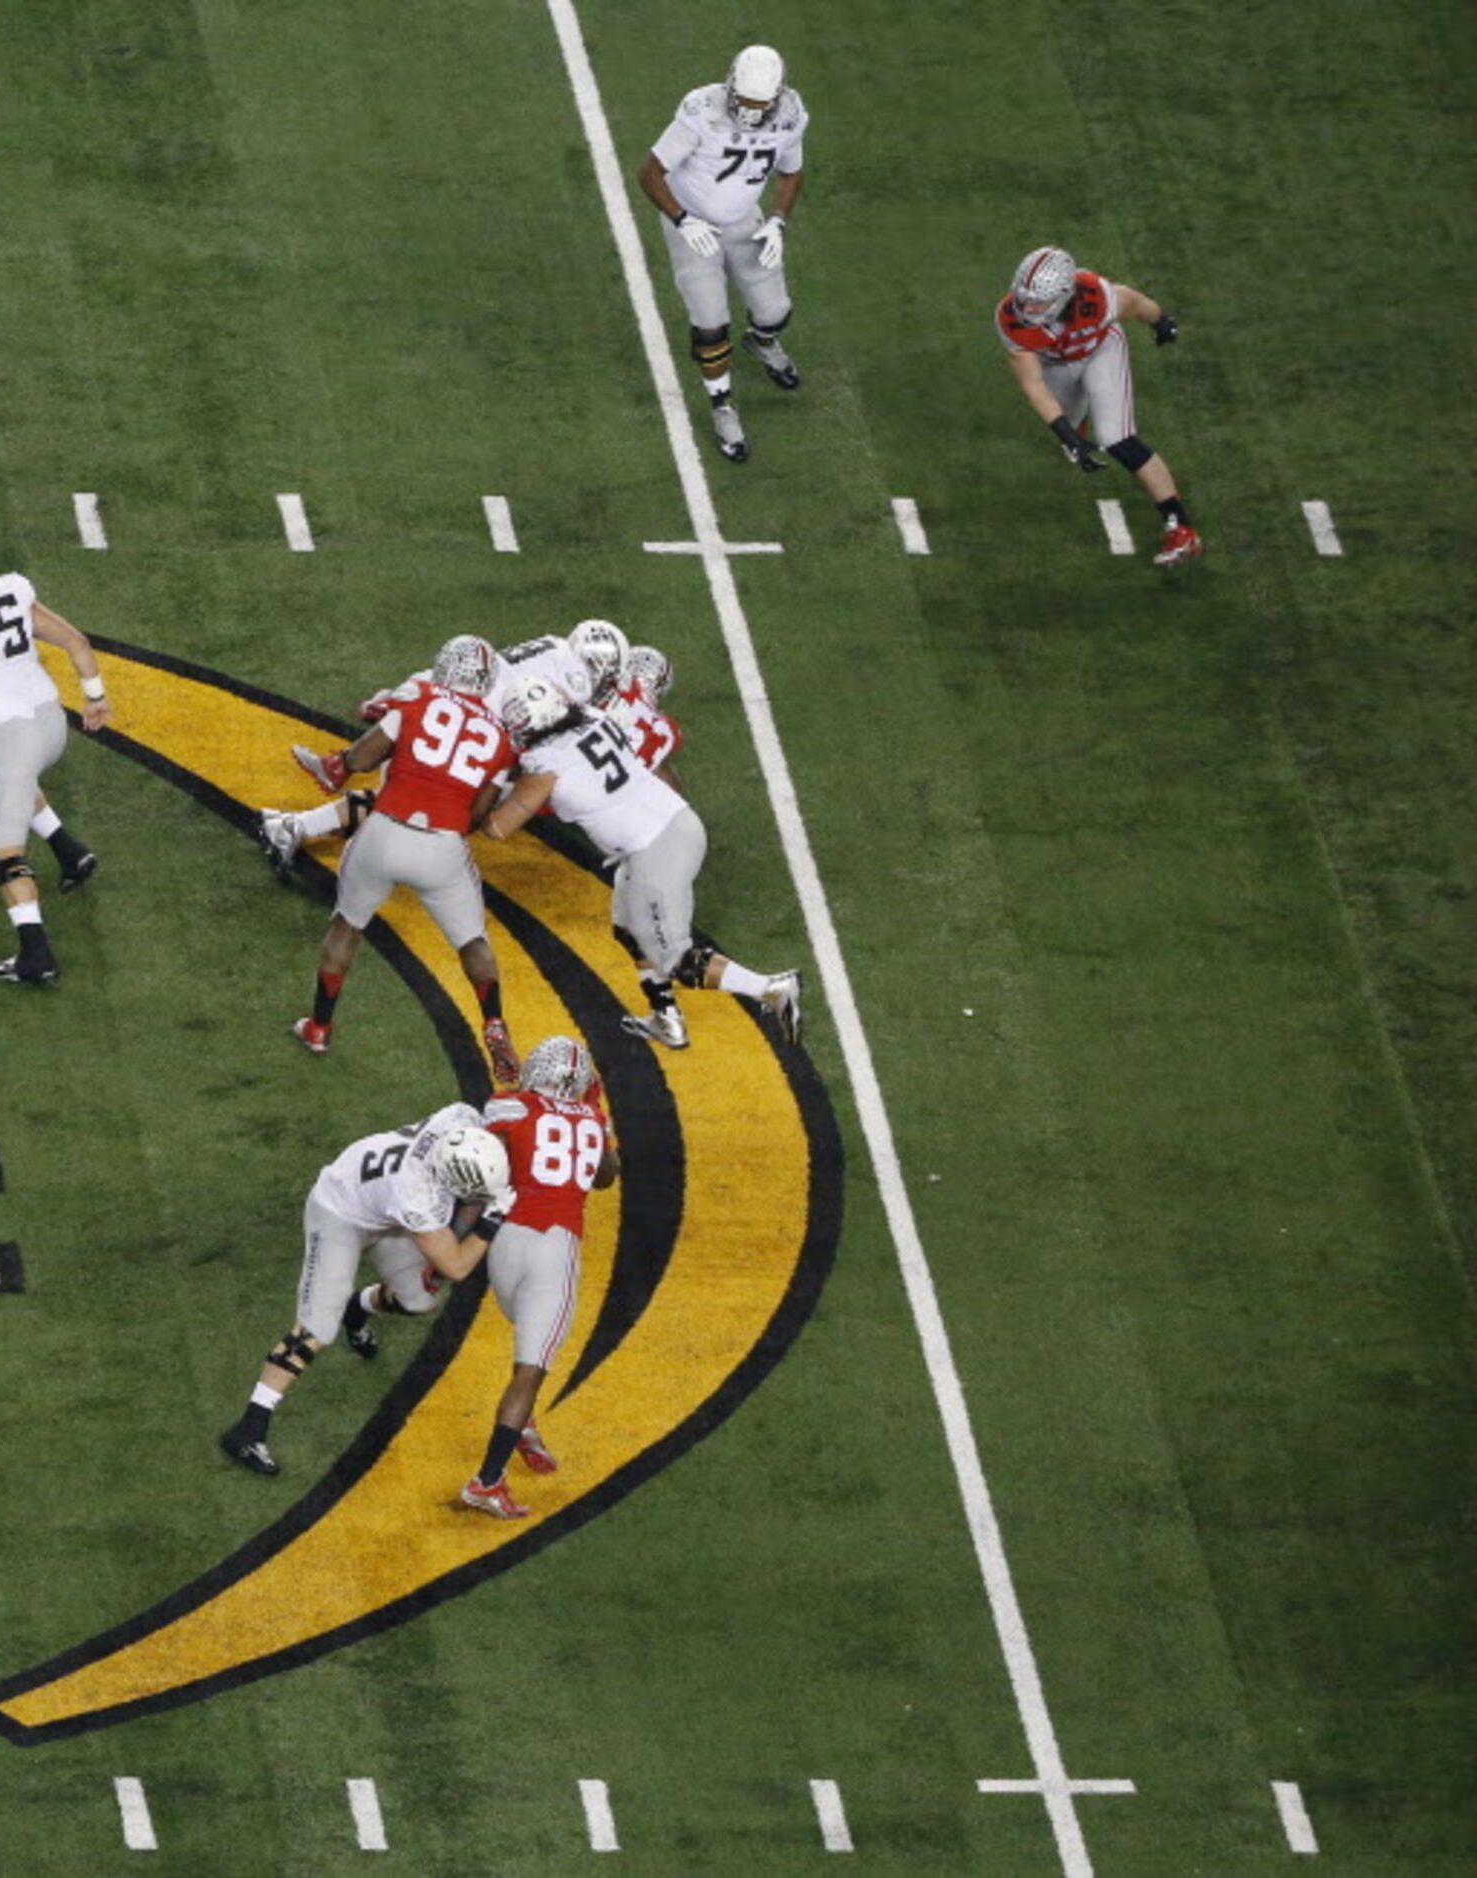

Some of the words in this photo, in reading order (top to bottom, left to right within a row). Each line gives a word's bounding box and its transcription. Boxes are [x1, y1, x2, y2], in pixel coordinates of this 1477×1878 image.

[716, 147, 776, 185] 73
[412, 698, 500, 788] 92
[530, 1113, 604, 1191] 88
